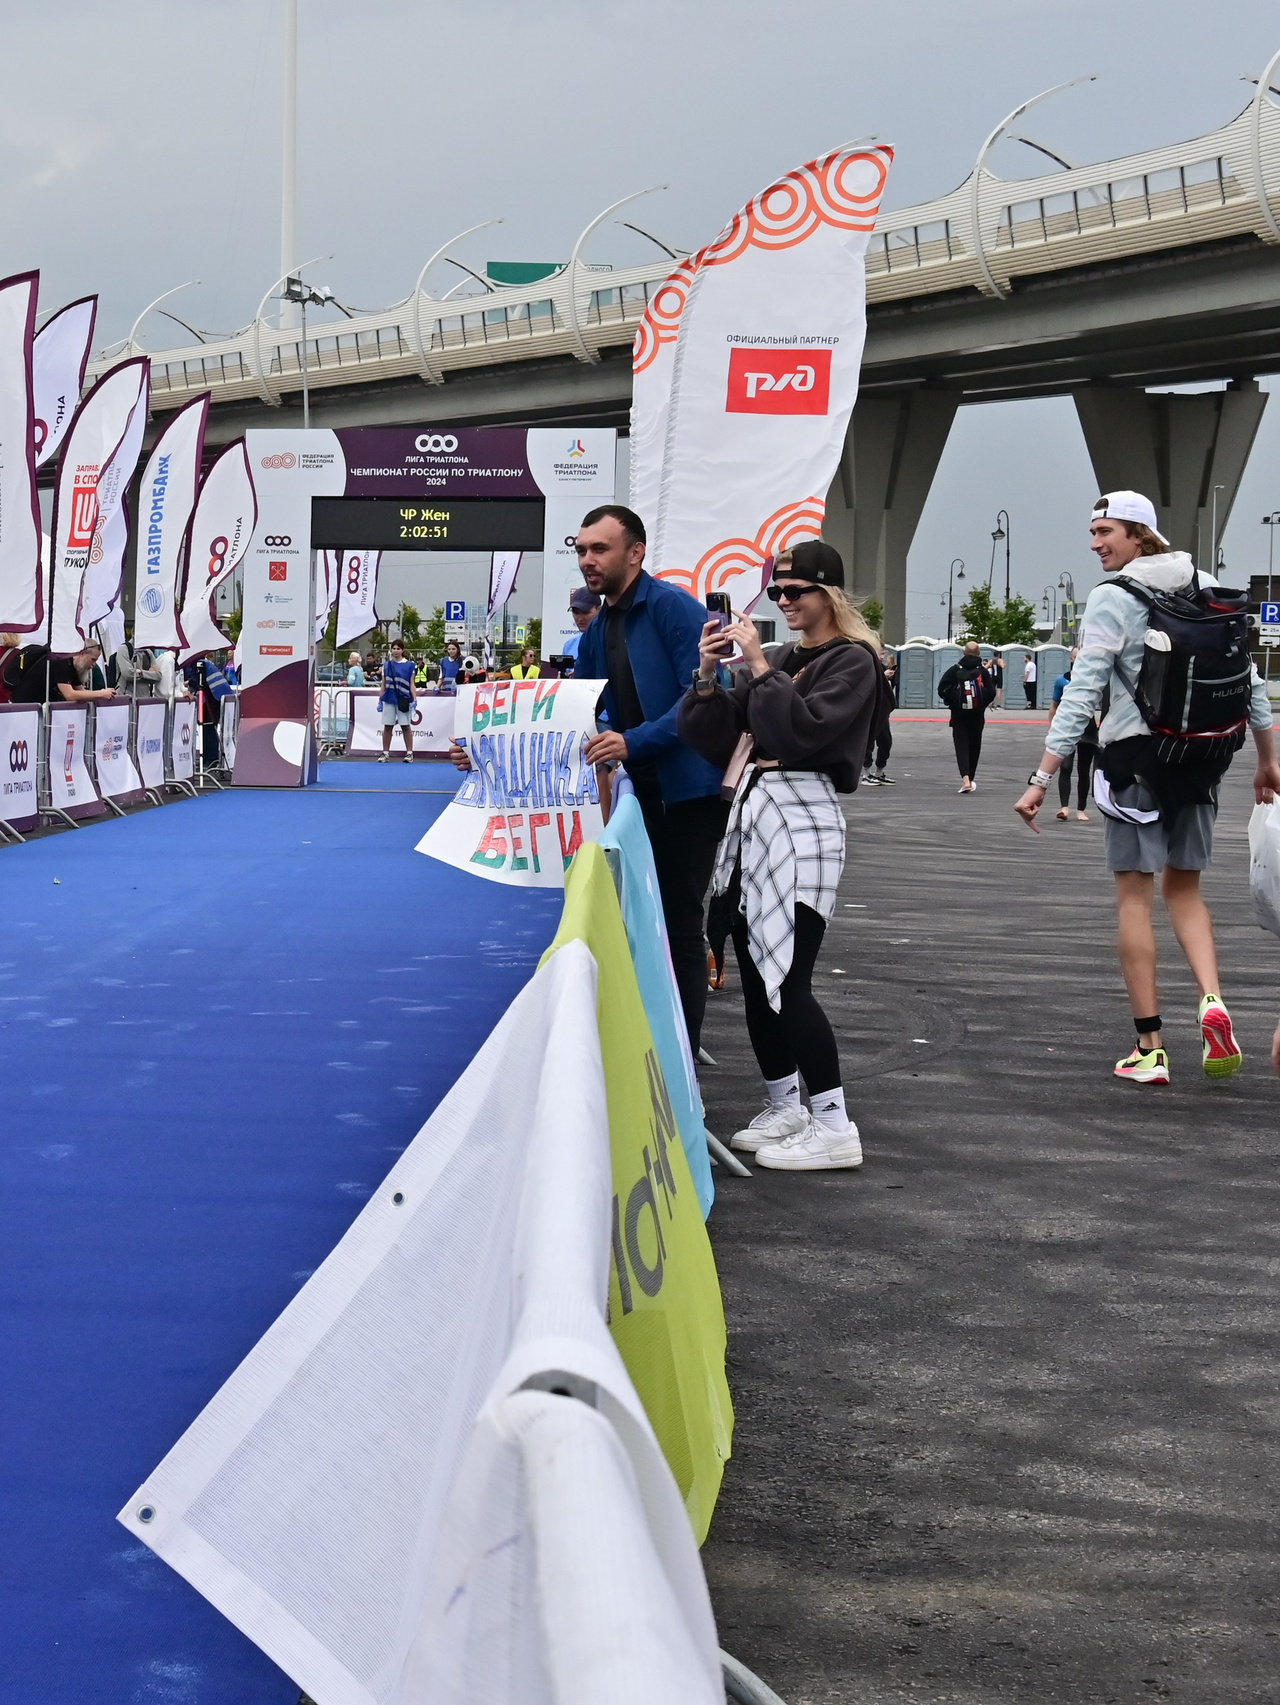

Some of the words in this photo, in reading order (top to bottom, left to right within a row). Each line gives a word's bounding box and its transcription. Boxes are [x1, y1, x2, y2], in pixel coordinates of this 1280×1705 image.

[726, 335, 798, 344] ОФИЦИАЛЬНЫЙ
[800, 336, 839, 345] ПАРТНЕР
[350, 468, 408, 476] ЧЕМПИОНАТ
[468, 469, 524, 477] ТРИАТЛОНУ
[147, 453, 172, 575] ГАЗПРОМБАНК
[400, 509, 417, 520] ЧР
[420, 509, 450, 520] Жен
[400, 526, 448, 538] 2:02:51
[362, 550, 370, 586] ТРИАТЛО
[1212, 685, 1245, 699] HUUB
[472, 680, 562, 732] БЕГИ
[395, 730, 434, 738] ТРТЛОНА
[470, 811, 585, 873] БЕГИ
